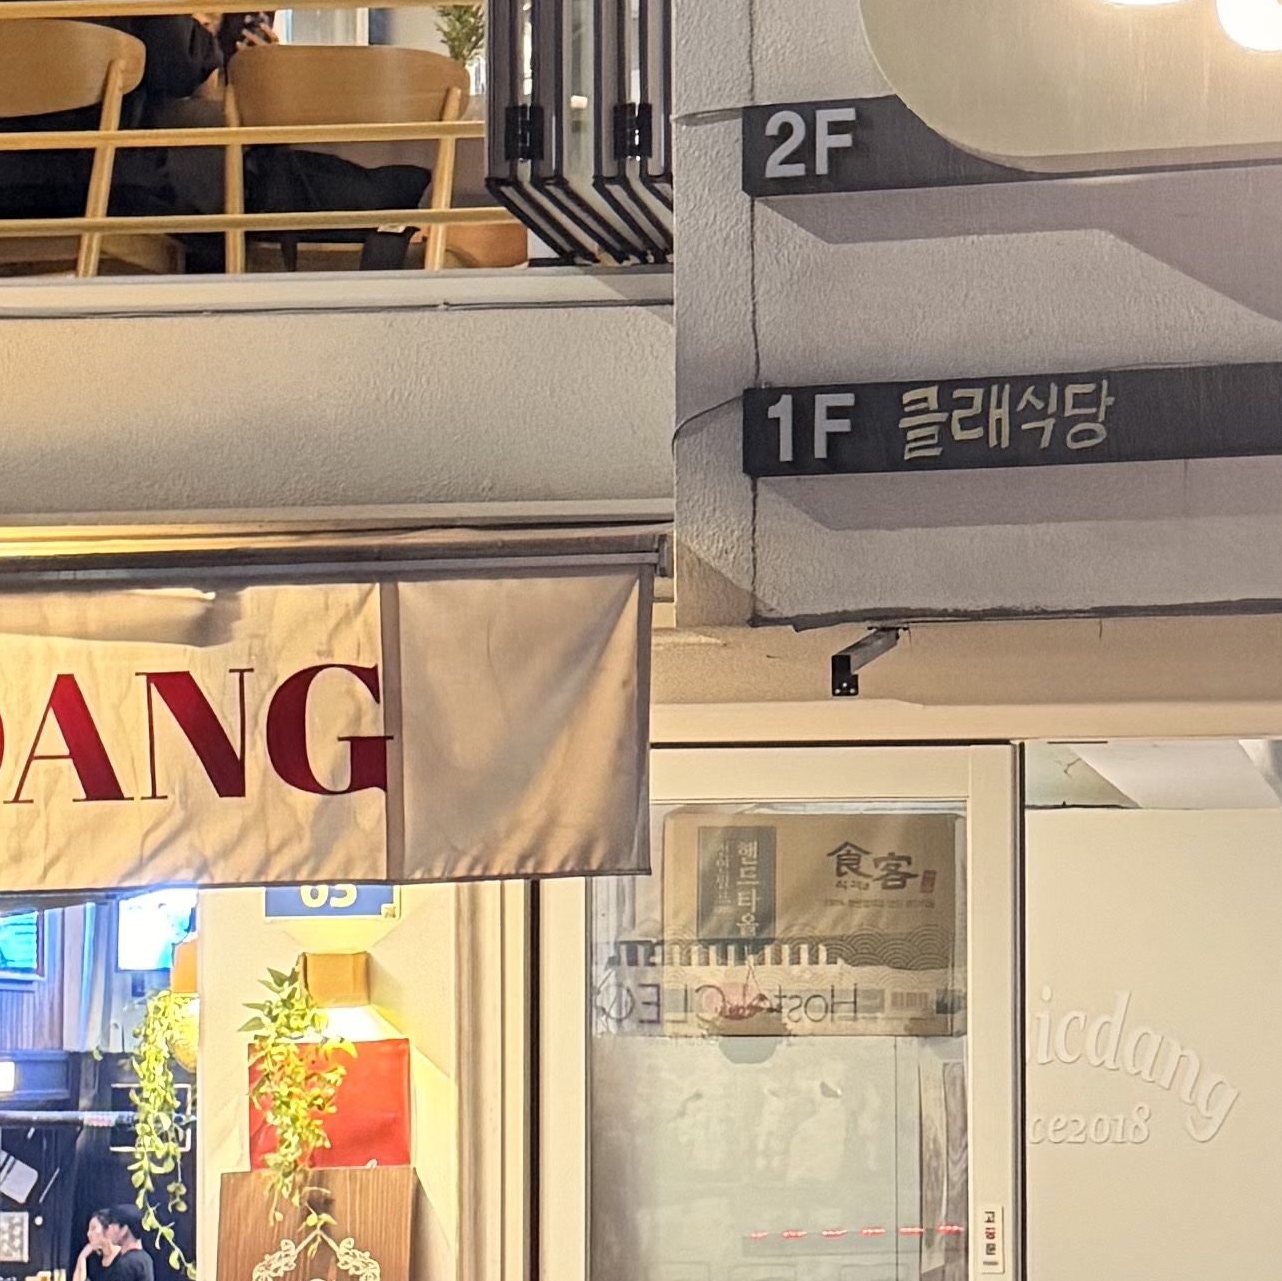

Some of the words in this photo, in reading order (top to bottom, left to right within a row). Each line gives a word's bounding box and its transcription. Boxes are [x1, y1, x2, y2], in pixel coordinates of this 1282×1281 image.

[762, 107, 858, 179] 2F
[767, 393, 855, 463] 1F
[899, 379, 1115, 461] 클래식당
